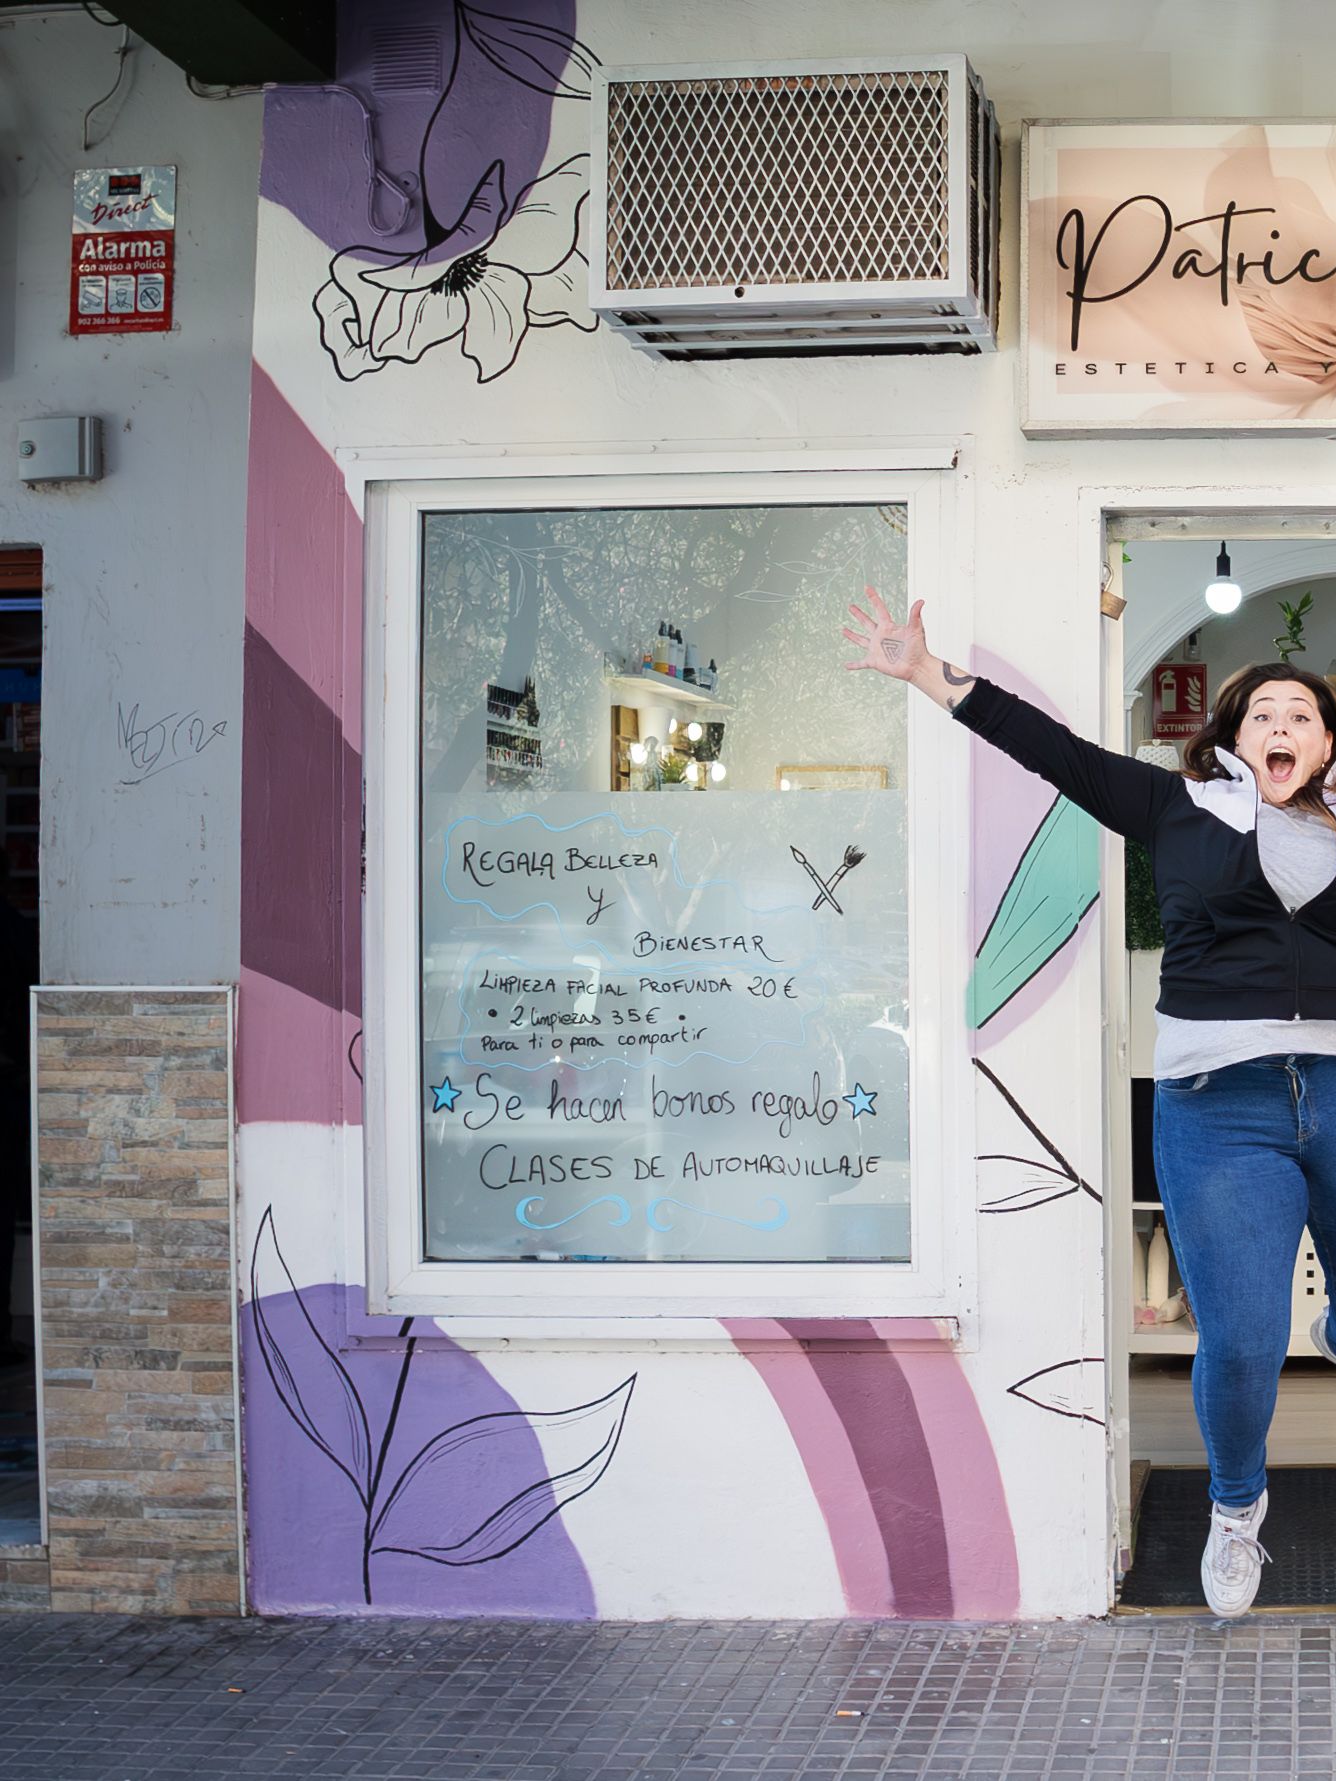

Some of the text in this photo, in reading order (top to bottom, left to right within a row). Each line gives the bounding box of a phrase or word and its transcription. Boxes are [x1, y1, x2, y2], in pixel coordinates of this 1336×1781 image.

[91, 192, 160, 225] Direct
[80, 237, 166, 260] Alarma
[78, 261, 97, 272] con
[98, 260, 124, 272] aviso
[125, 261, 132, 271] a
[1055, 362, 1279, 376] ESTETICA
[1319, 361, 1336, 374] Y
[1156, 723, 1203, 733] EXTINTOR
[463, 842, 658, 887] REGALA BELLEZA
[567, 979, 628, 997] FACIAL
[639, 977, 732, 994] PROFUNDA
[510, 1006, 525, 1026] 2
[530, 1005, 600, 1032] limpiezas
[481, 1027, 708, 1055] Para ti o para compartir
[463, 1071, 839, 1138] Se hacen bonos regalo
[480, 1144, 882, 1190] CLASES DE AUTOMAQUILLAJE
